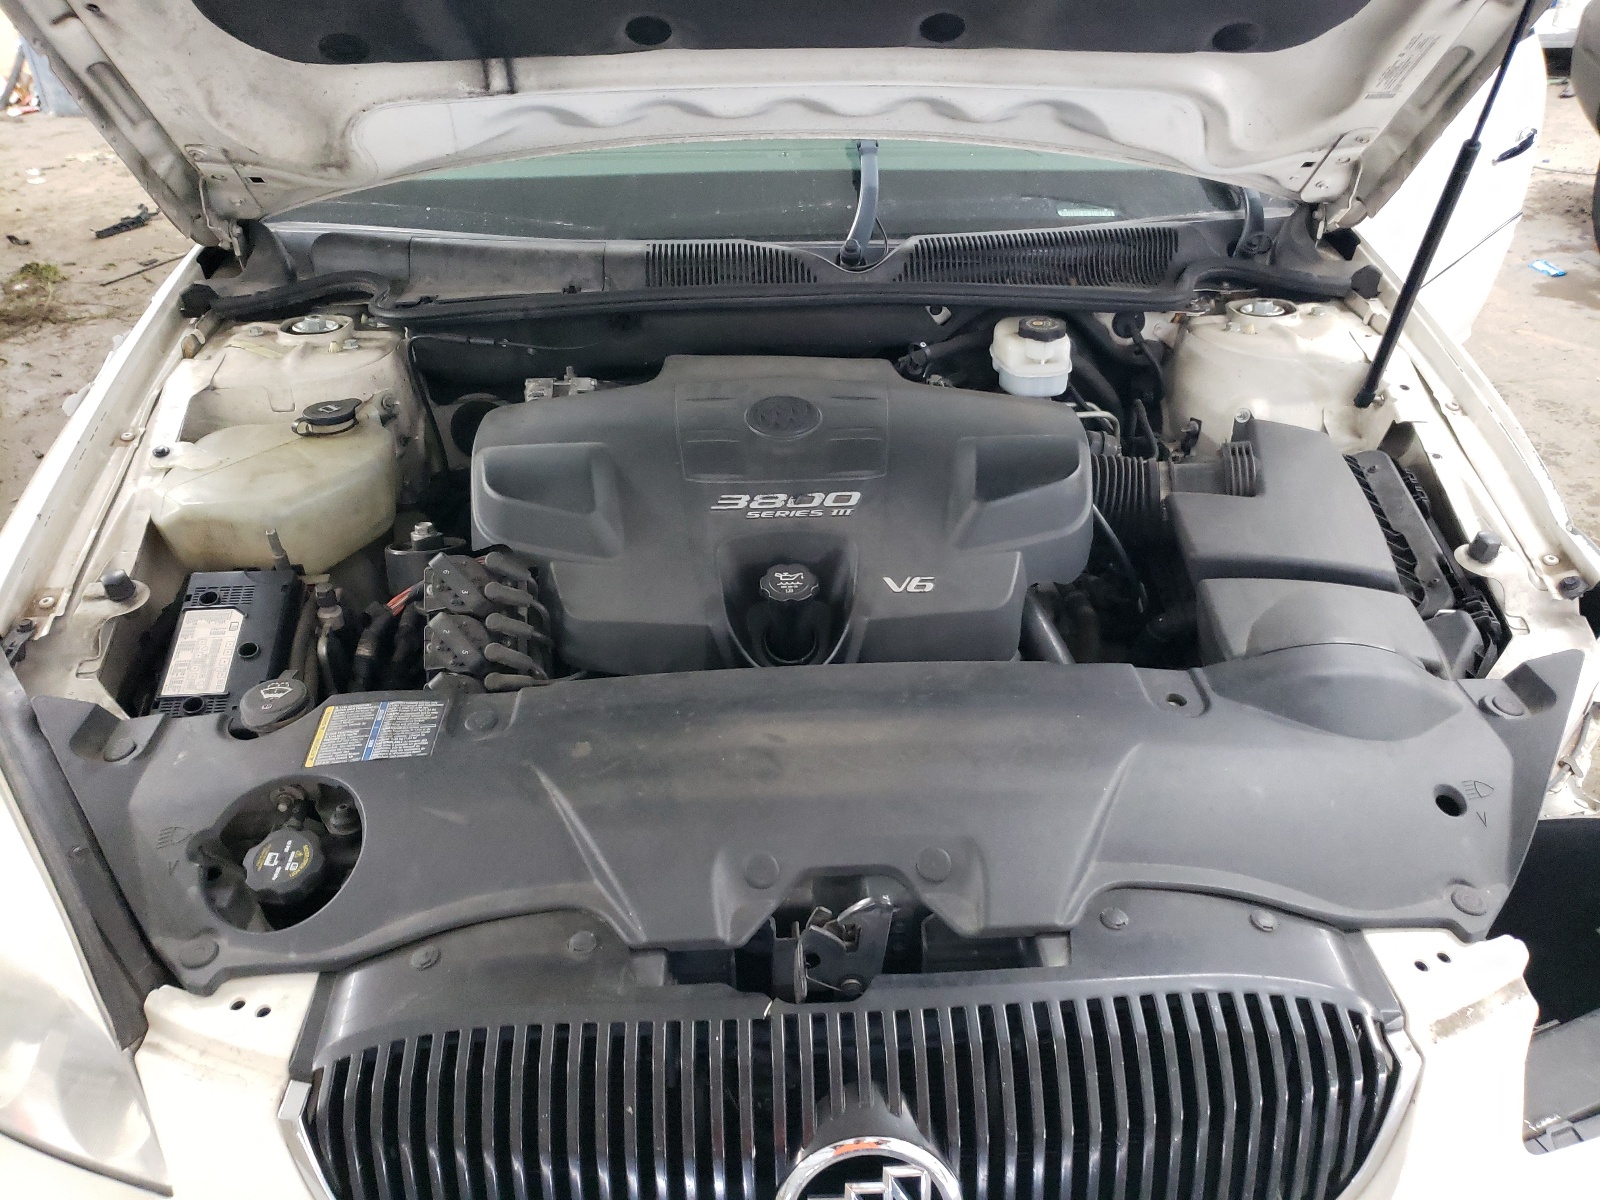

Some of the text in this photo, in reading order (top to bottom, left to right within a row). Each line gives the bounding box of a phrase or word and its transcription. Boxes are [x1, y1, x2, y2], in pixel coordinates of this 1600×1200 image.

[711, 491, 862, 510] 3800
[746, 508, 855, 519] SERIES III
[883, 576, 935, 593] V6
